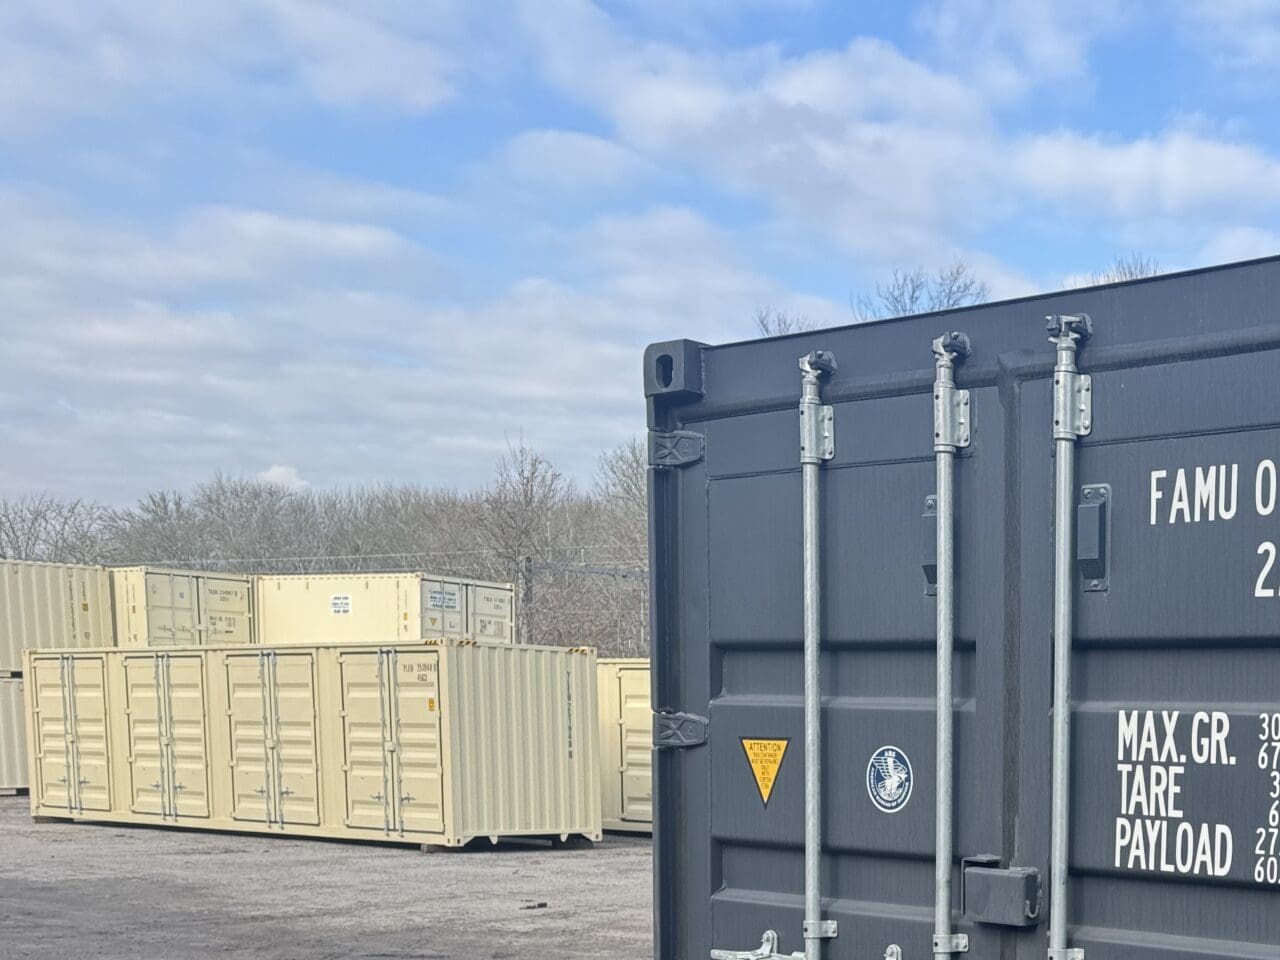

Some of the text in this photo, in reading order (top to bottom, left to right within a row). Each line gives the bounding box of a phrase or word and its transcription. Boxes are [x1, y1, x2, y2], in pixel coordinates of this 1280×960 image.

[1149, 463, 1239, 525] FAMU
[1117, 709, 1187, 763] MAX.
[1190, 711, 1237, 765] GR.
[1116, 763, 1185, 818] TARE
[1114, 818, 1233, 877] PAYLOAD
